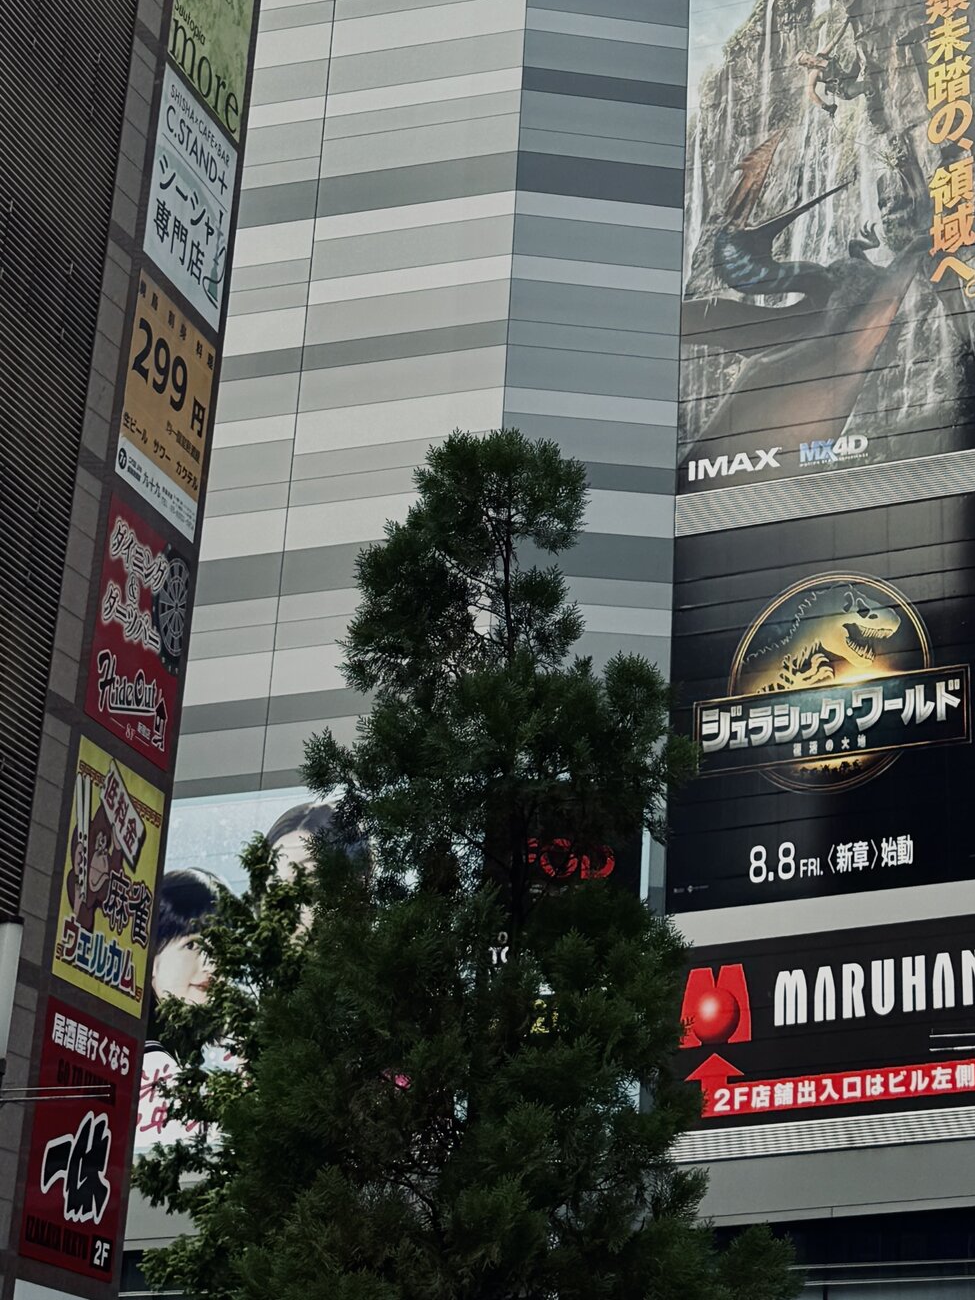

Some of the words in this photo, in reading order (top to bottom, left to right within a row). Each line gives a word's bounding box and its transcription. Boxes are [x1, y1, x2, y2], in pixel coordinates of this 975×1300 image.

[171, 18, 239, 134] more
[153, 198, 206, 286] 専門店
[688, 446, 781, 482] IMAX
[799, 435, 869, 463] MX4D
[701, 678, 961, 753] ジュラシック・ワールド
[749, 841, 797, 884] 8.8
[103, 868, 151, 948] 麻雀
[52, 1012, 131, 1076] 居酒屋行くなら
[93, 1240, 111, 1267] 2F
